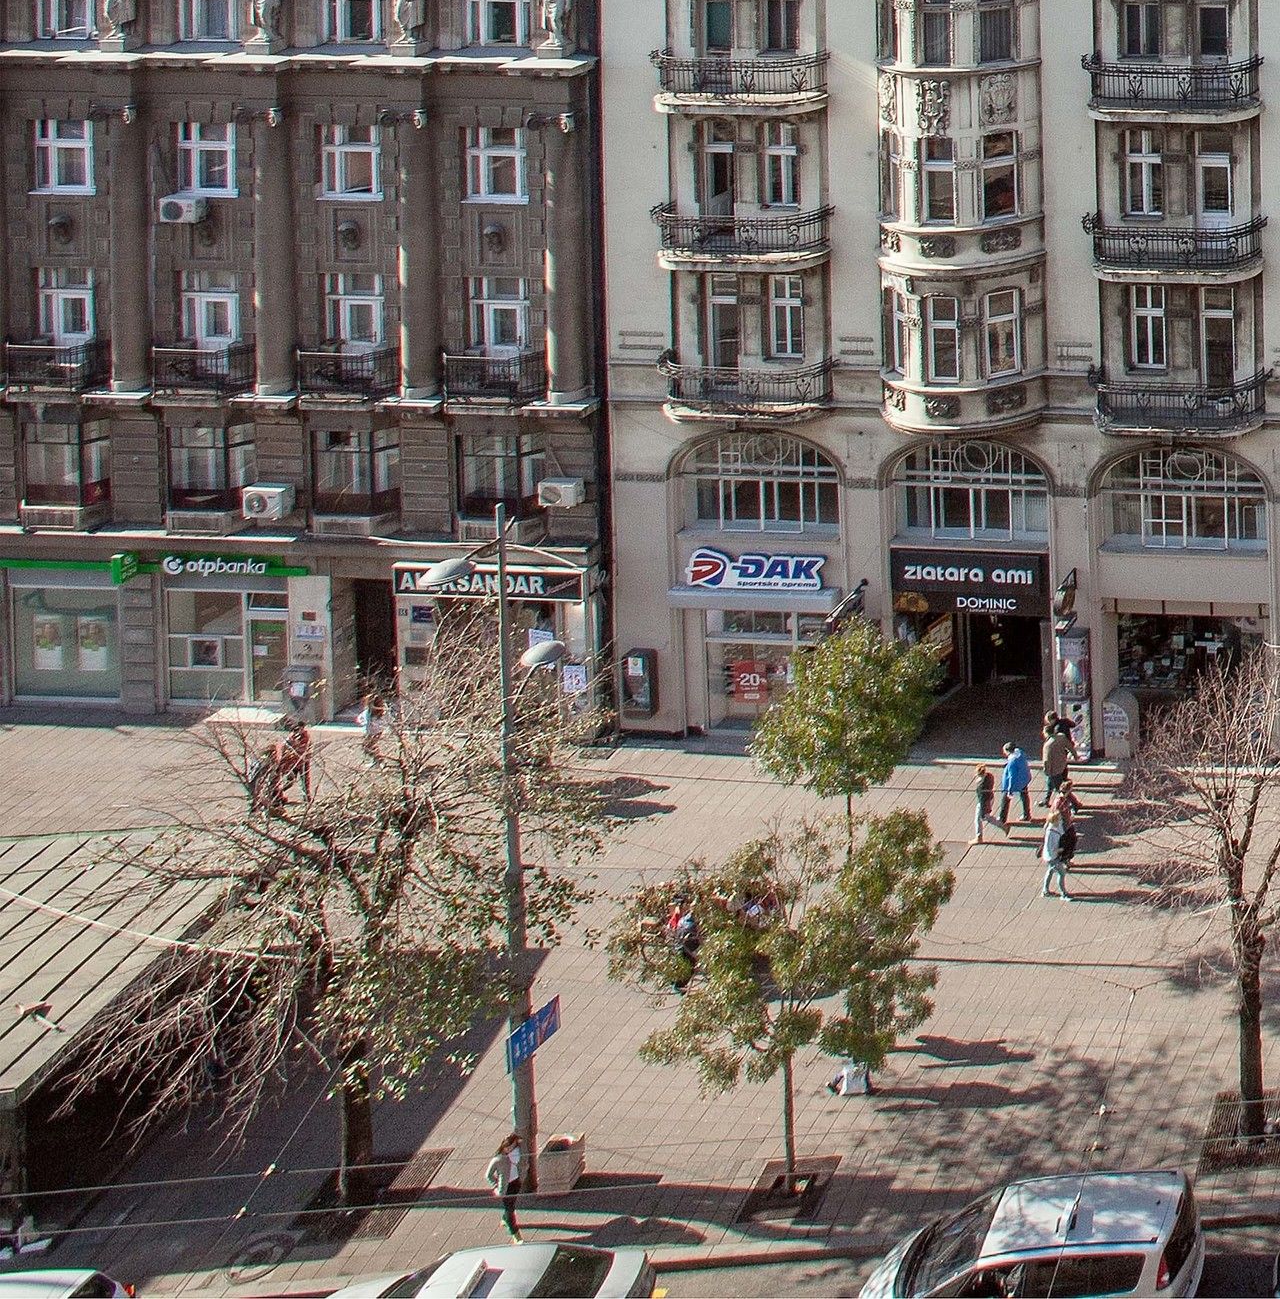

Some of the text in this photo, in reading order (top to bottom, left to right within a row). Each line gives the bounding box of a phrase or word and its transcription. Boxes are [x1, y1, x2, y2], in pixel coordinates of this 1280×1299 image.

[186, 557, 266, 577] otpbanka
[904, 564, 1033, 585] zlatara ami
[956, 596, 1017, 611] DOMINIC
